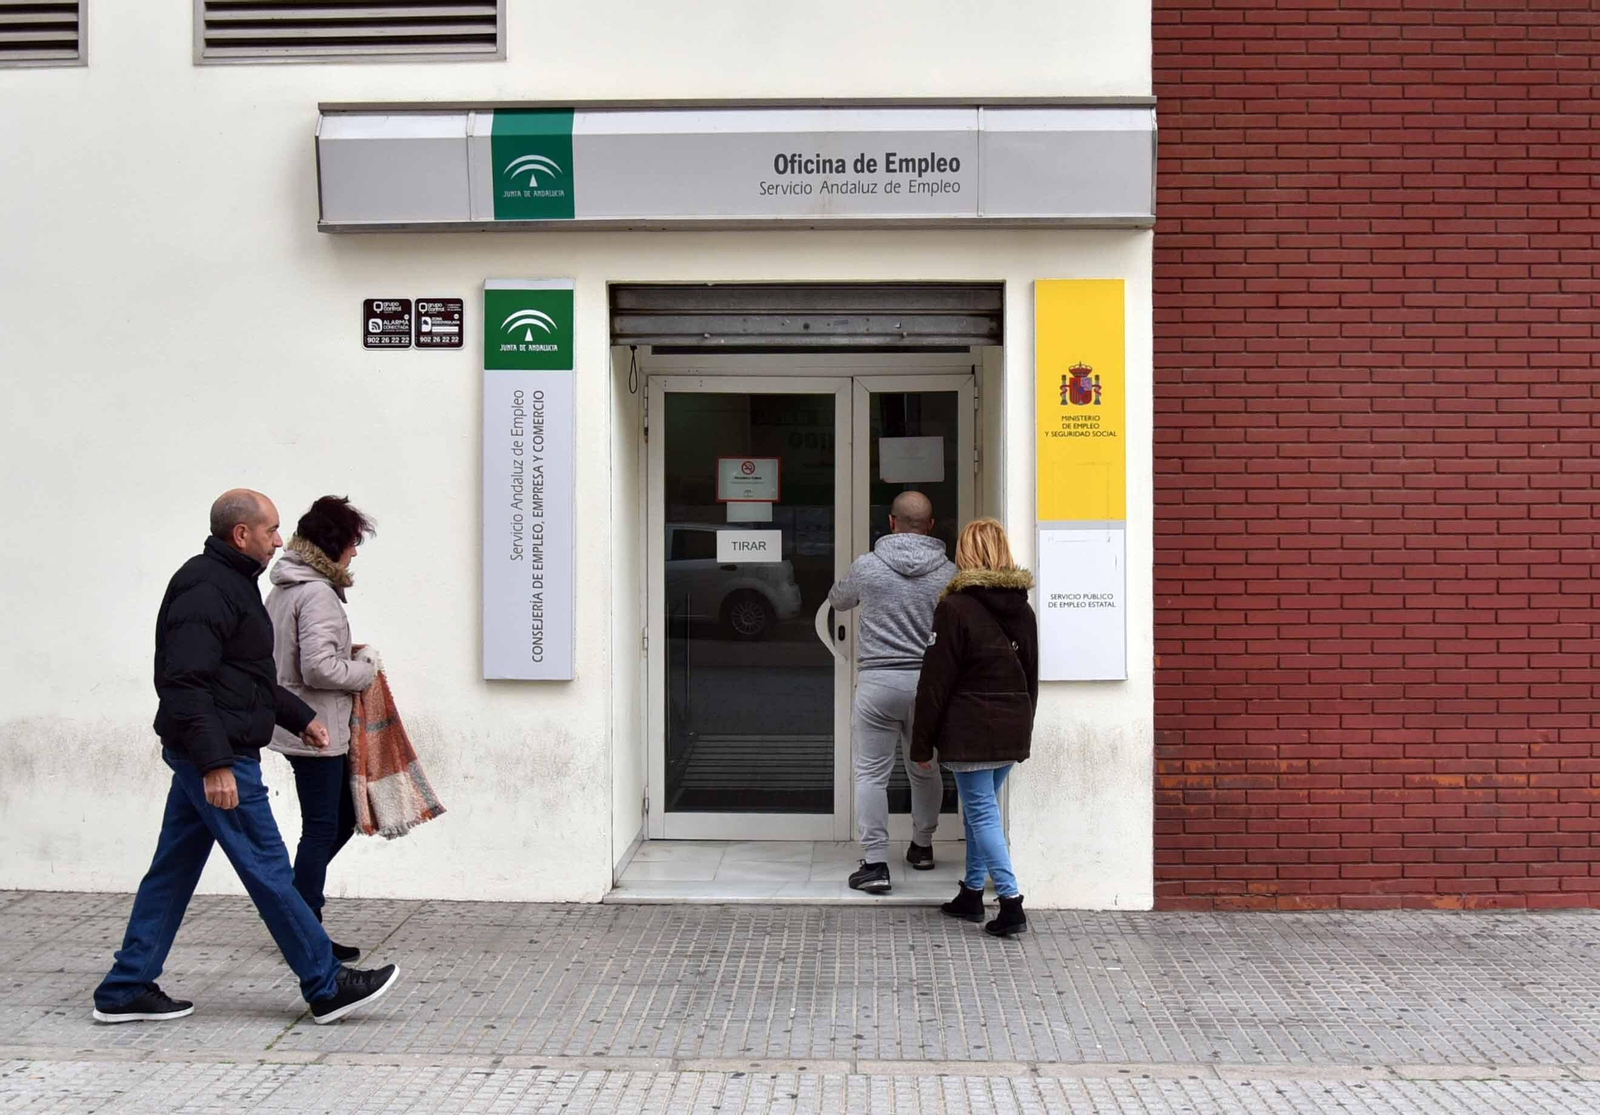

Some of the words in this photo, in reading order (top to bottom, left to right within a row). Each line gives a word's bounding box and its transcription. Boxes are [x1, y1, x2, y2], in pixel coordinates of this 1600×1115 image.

[773, 153, 846, 175] Oficina
[853, 152, 878, 174] de
[885, 152, 961, 178] Empleo
[503, 190, 521, 198] JUNTA
[524, 190, 531, 198] DE
[759, 181, 813, 196] Servicio
[819, 180, 878, 195] Andaluz
[884, 180, 902, 194] de
[908, 179, 961, 197] Empleo
[511, 389, 528, 437] Empleo
[532, 390, 544, 453] COMERCIO
[511, 440, 524, 457] de
[532, 454, 544, 463] Y
[511, 459, 524, 511] Andaluz
[532, 464, 544, 518] EMPRESA
[510, 513, 524, 562] Servicio
[532, 520, 546, 571] EMPLEO,
[731, 541, 767, 551] TIRAR
[532, 572, 544, 590] DE
[529, 592, 544, 663] CONSEJERÍA
